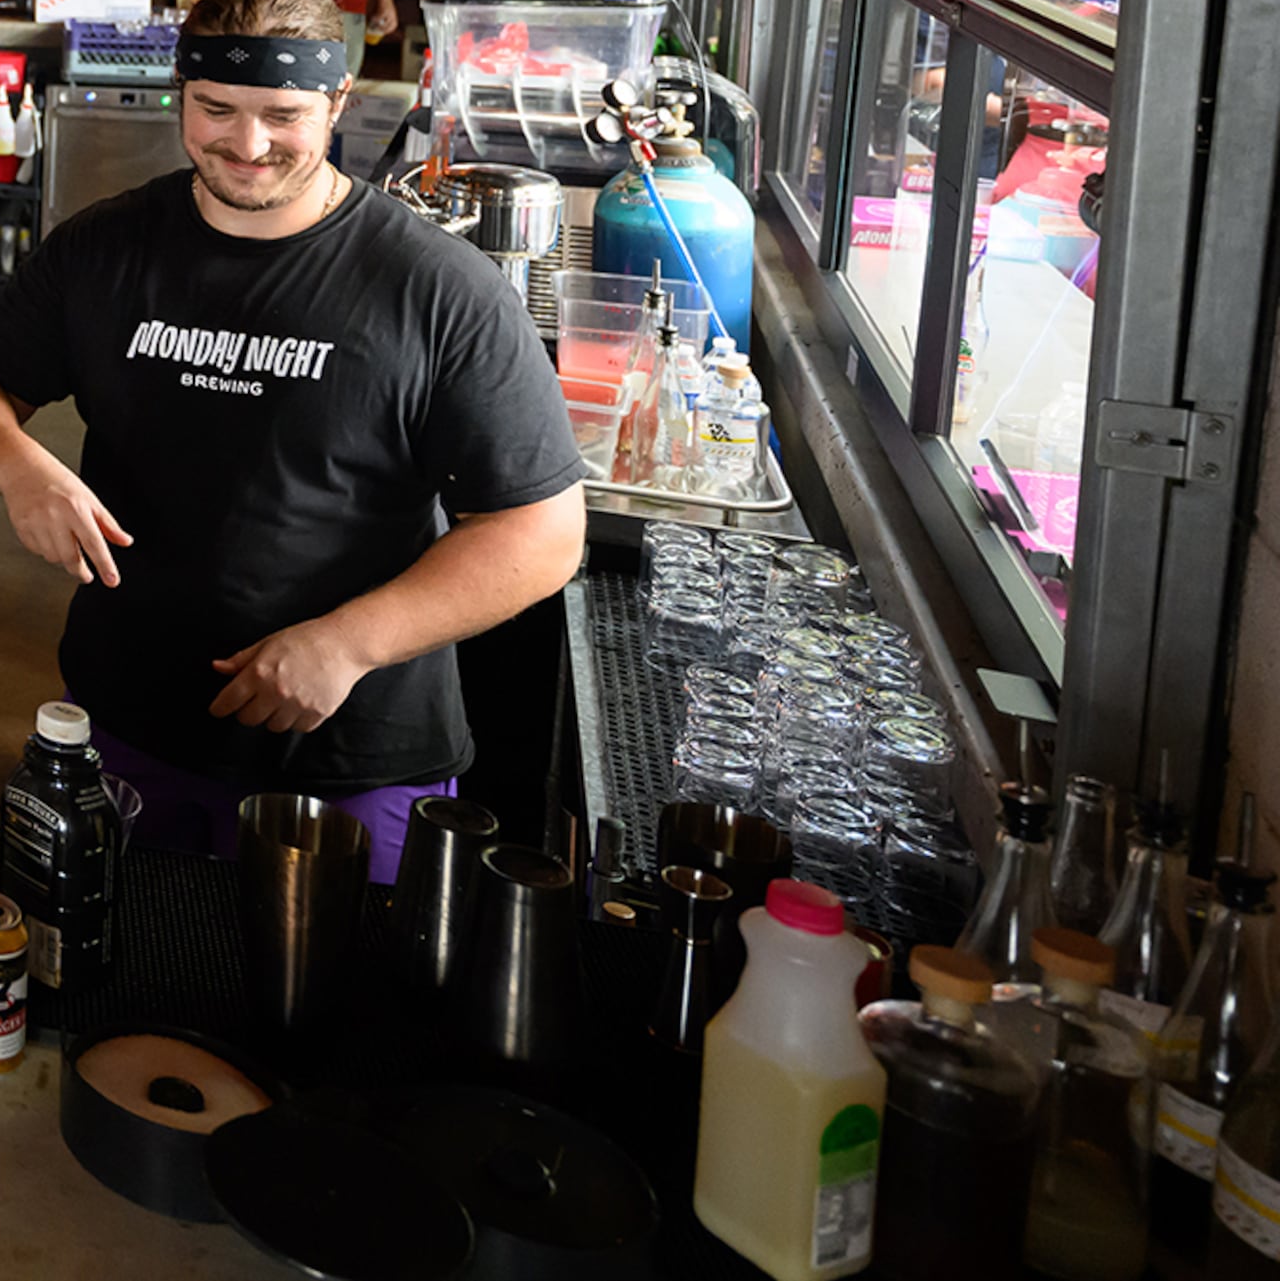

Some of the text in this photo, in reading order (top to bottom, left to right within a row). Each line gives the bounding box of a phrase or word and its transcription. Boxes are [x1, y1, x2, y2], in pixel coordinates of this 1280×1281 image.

[126, 320, 335, 380] MONDAY NIGHT
[180, 372, 264, 396] BREWING
